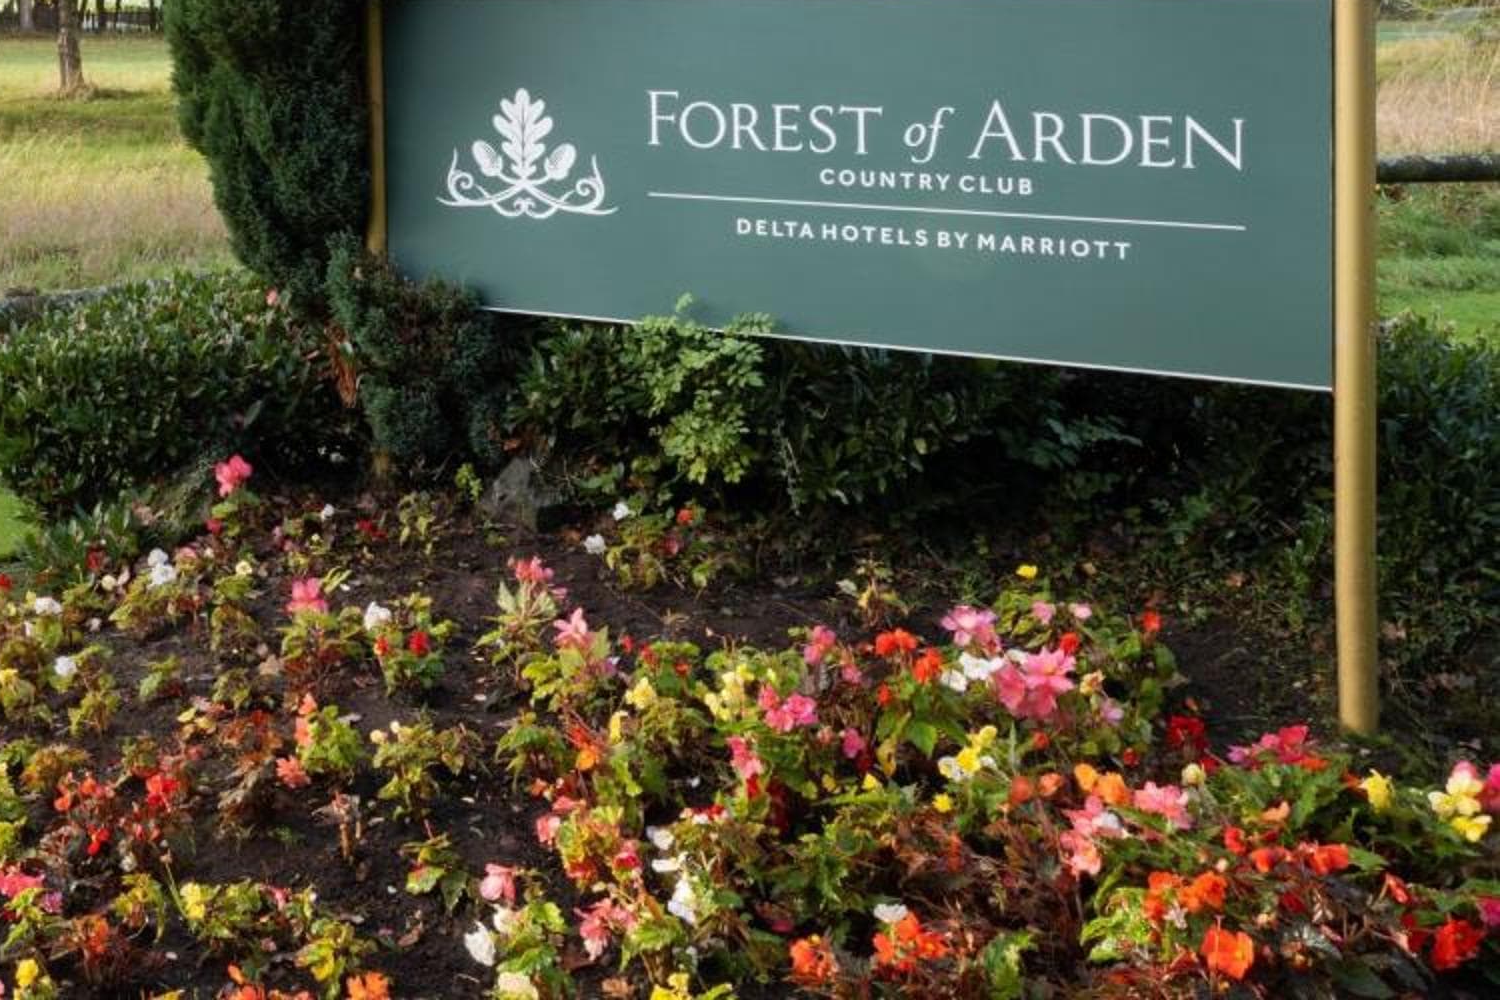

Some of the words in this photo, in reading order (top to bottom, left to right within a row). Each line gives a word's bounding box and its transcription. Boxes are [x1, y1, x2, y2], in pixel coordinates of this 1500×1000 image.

[648, 90, 883, 156] FOREST
[903, 106, 956, 164] of
[967, 100, 1246, 171] ARDEN
[819, 167, 950, 191] COUNTRY
[958, 174, 1034, 195] CLUB
[736, 217, 815, 240] DELTA
[821, 223, 929, 247] HOTELS
[937, 230, 970, 249] BY
[977, 233, 1132, 260] MARRIOTT
